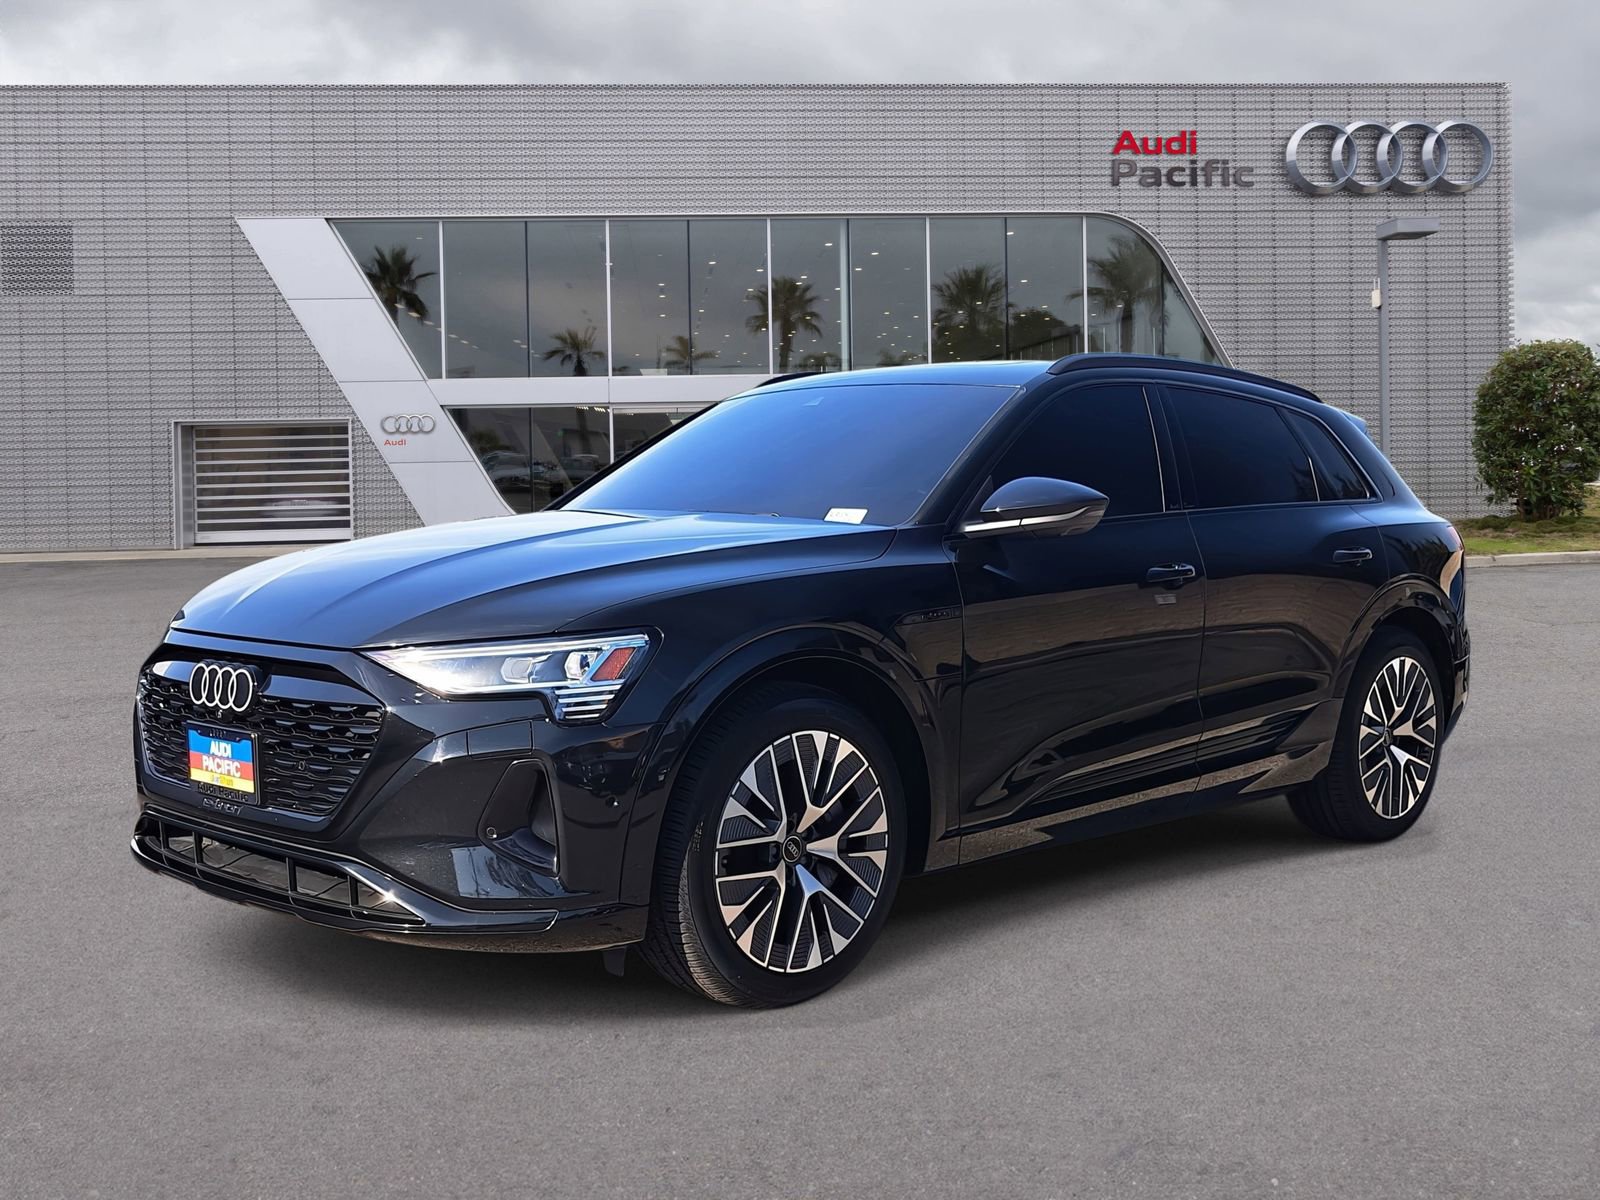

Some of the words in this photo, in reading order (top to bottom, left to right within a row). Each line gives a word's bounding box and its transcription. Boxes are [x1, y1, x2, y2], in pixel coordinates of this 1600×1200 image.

[1111, 130, 1198, 155] Audi
[1111, 159, 1255, 187] Pacific
[384, 438, 407, 446] Audi
[209, 740, 232, 759] AUDI
[202, 755, 241, 778] PACIFIC
